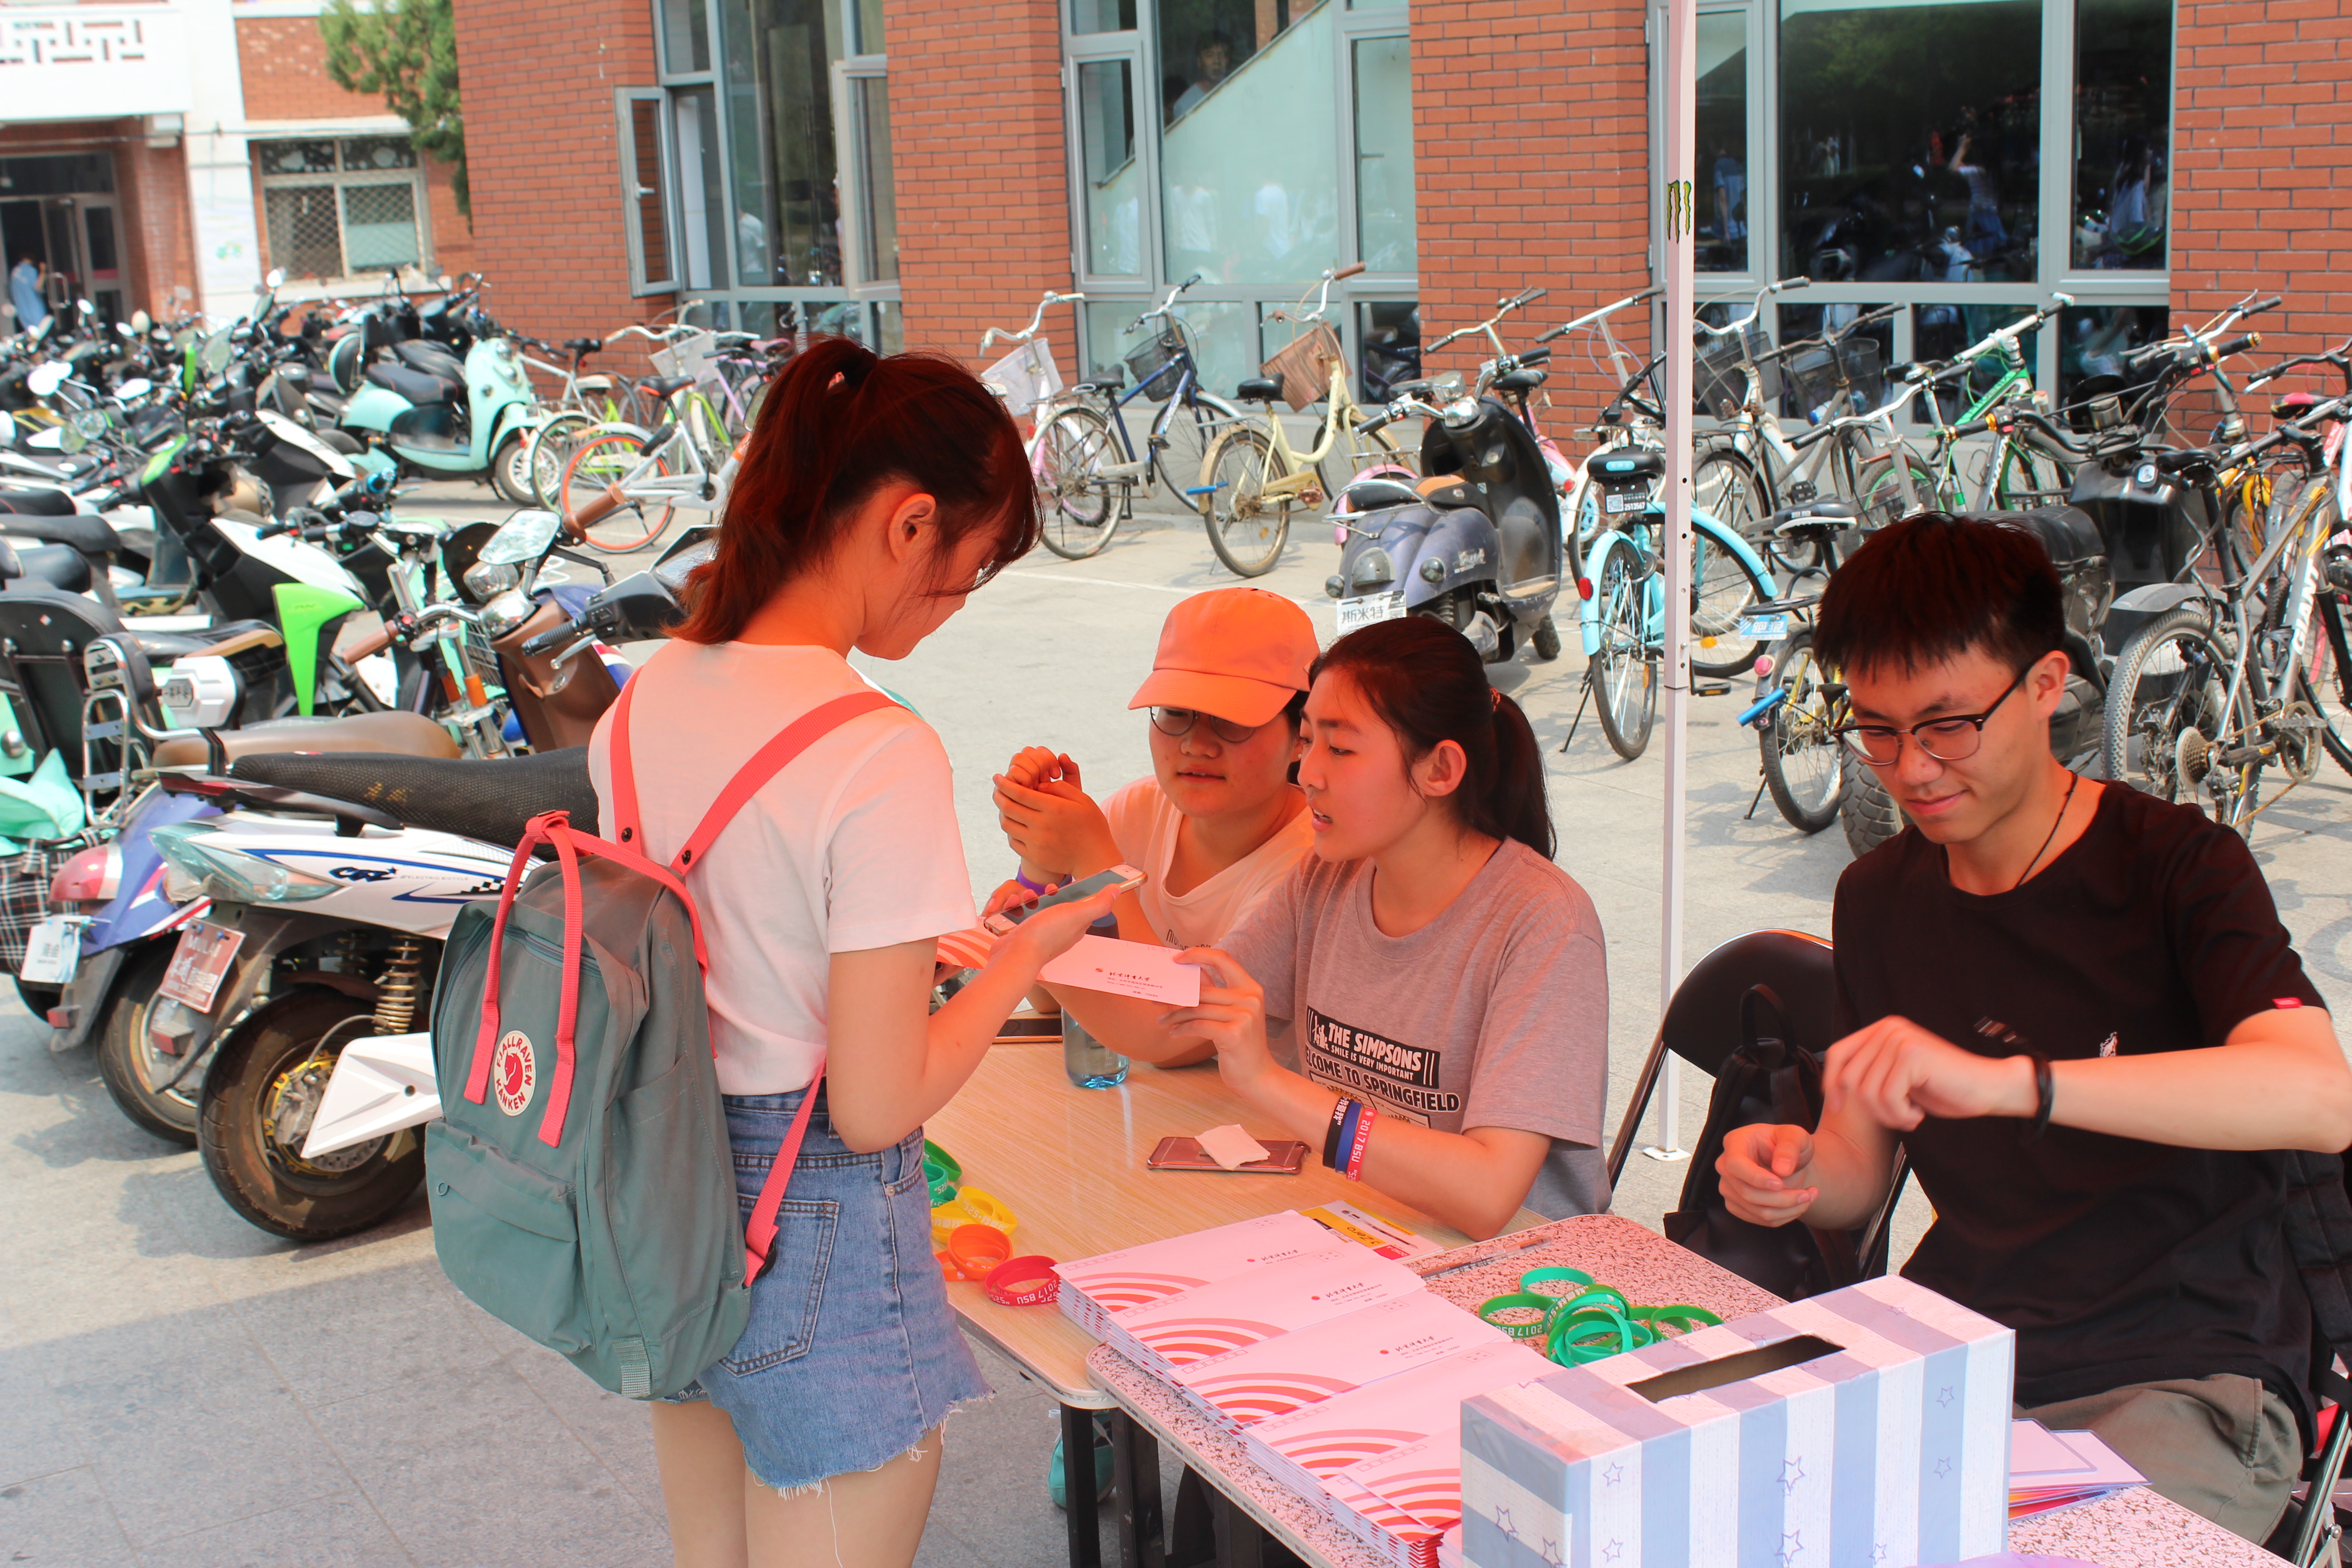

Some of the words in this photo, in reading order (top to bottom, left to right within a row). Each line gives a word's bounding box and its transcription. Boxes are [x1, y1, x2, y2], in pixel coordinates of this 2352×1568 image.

[1624, 501, 1646, 511] 2513567
[1342, 606, 1383, 624] 斯米特
[2292, 558, 2320, 656] GIANT
[1328, 1022, 1351, 1049] THE
[1354, 1033, 1422, 1071] SIMPSONS
[1331, 1044, 1349, 1059] SMILE
[1351, 1052, 1357, 1062] IS
[1359, 1055, 1375, 1068] VERY
[1376, 1061, 1414, 1081] IMPORTANT
[1305, 1047, 1343, 1079] ELCOME
[1343, 1066, 1361, 1087] TO
[1363, 1073, 1460, 1112] SPRINGFIELD
[1357, 1119, 1371, 1143] 2017
[1351, 1143, 1363, 1163] BSU
[1016, 1293, 1037, 1304] BSU
[1038, 1279, 1058, 1298] 2017
[1517, 1323, 1543, 1337] 2017
